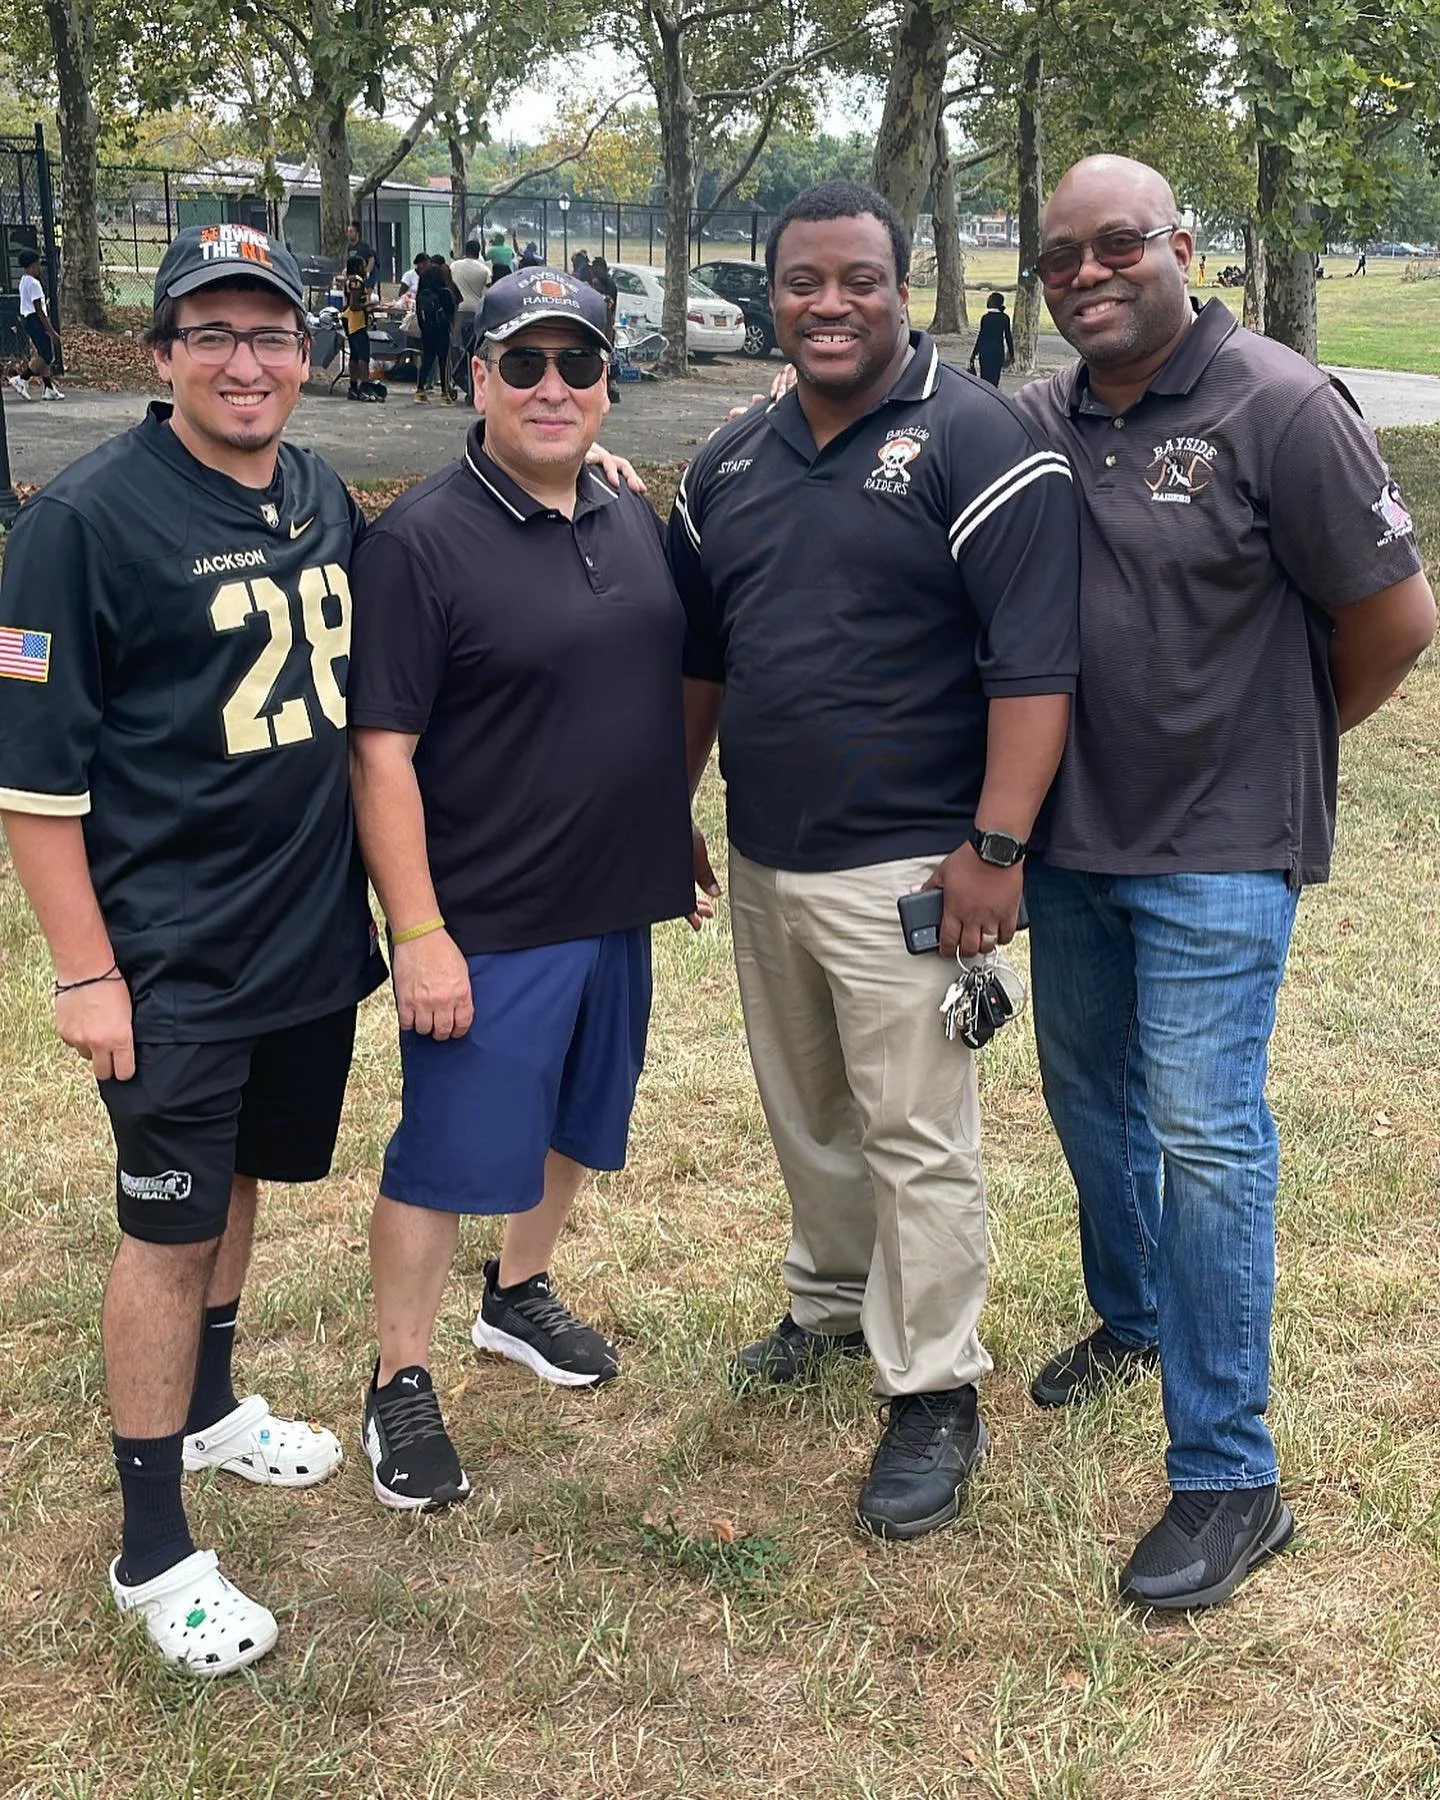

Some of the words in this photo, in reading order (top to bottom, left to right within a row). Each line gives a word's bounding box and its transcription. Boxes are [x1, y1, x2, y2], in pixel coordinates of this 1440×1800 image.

[199, 240, 240, 260] THE
[523, 297, 581, 309] RAIDERS
[885, 425, 930, 442] Bayside
[1153, 437, 1218, 461] BAYSIDE
[717, 458, 753, 474] STAFF
[863, 478, 910, 496] RAIDERS
[192, 549, 267, 576] JACKSON
[209, 562, 353, 755] 28
